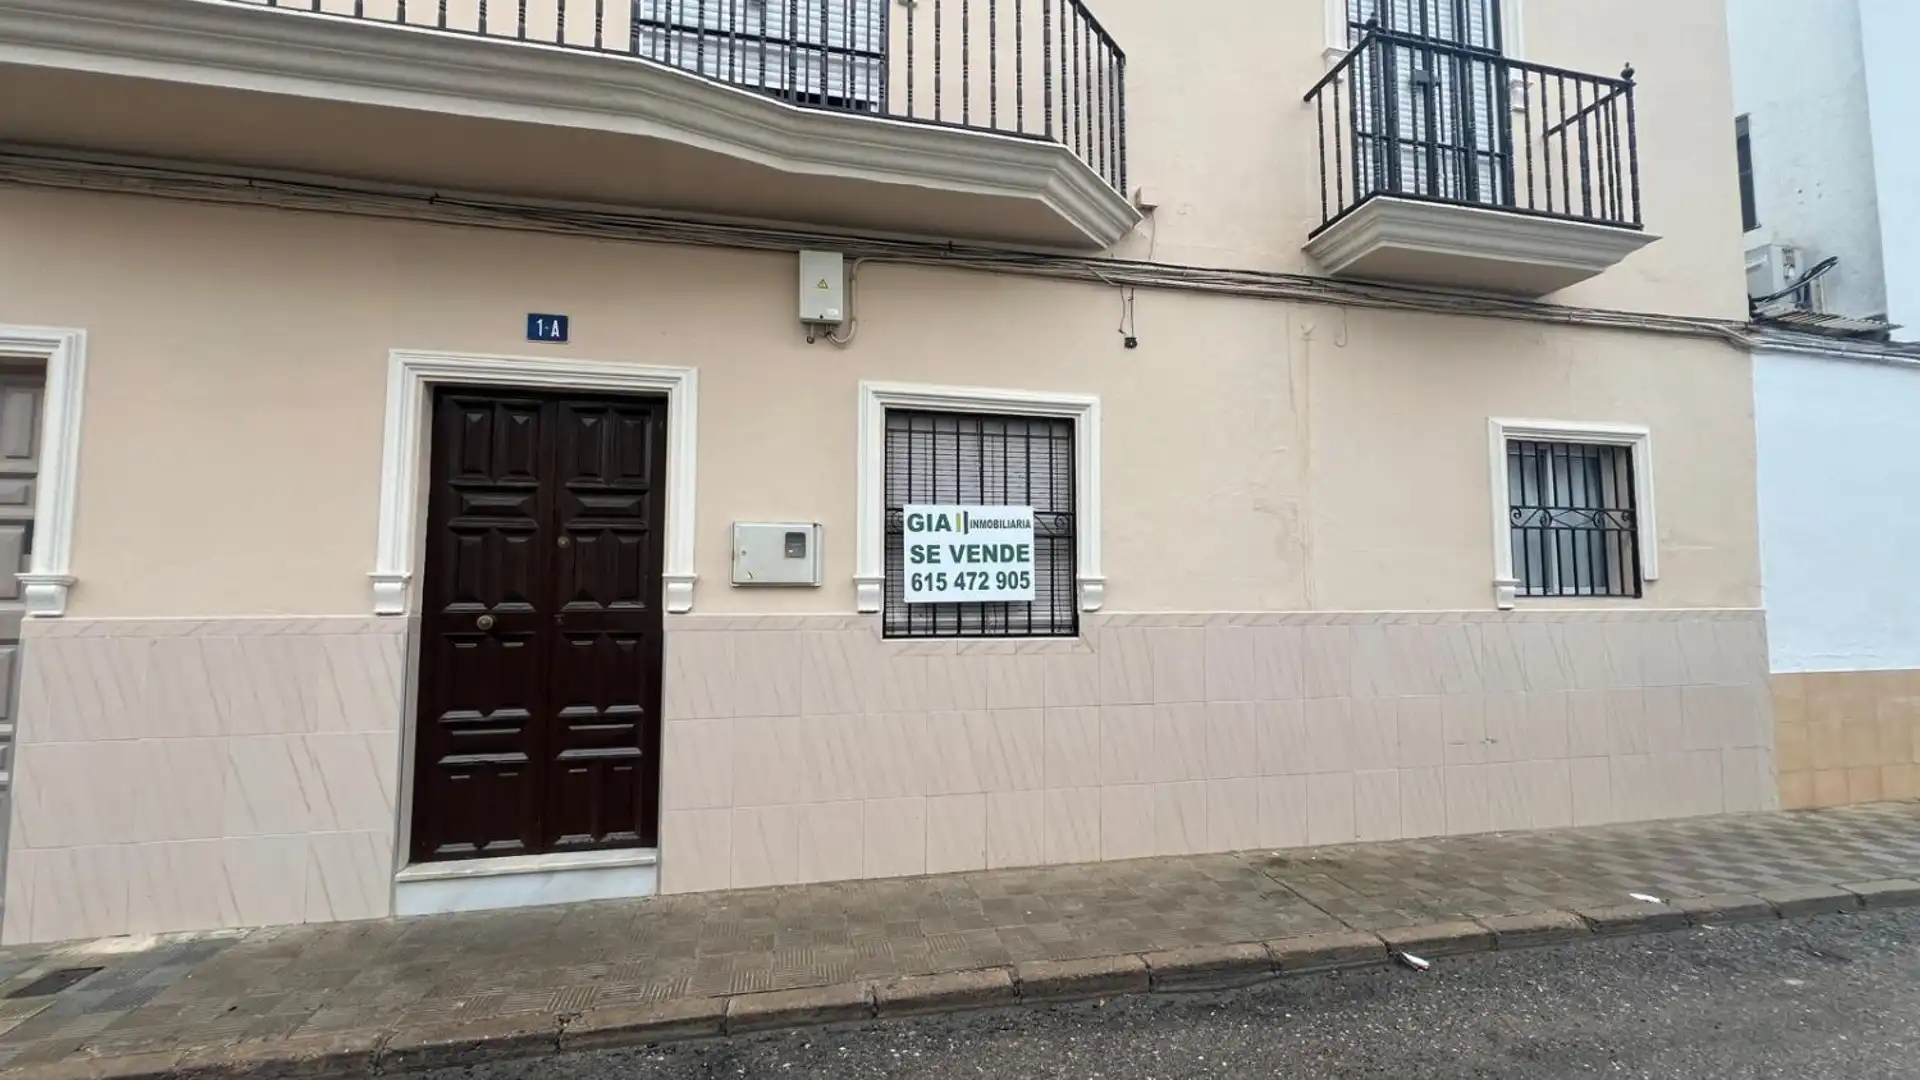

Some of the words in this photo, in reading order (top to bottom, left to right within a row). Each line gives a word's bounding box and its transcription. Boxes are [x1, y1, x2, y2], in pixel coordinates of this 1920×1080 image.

[907, 513, 952, 532] GIA
[969, 518, 1031, 529] INMOBILIARIA
[910, 544, 941, 564] SE
[949, 544, 1030, 563] VENDE
[911, 572, 948, 592] 615
[954, 571, 990, 590] 472
[996, 571, 1030, 590] 905
